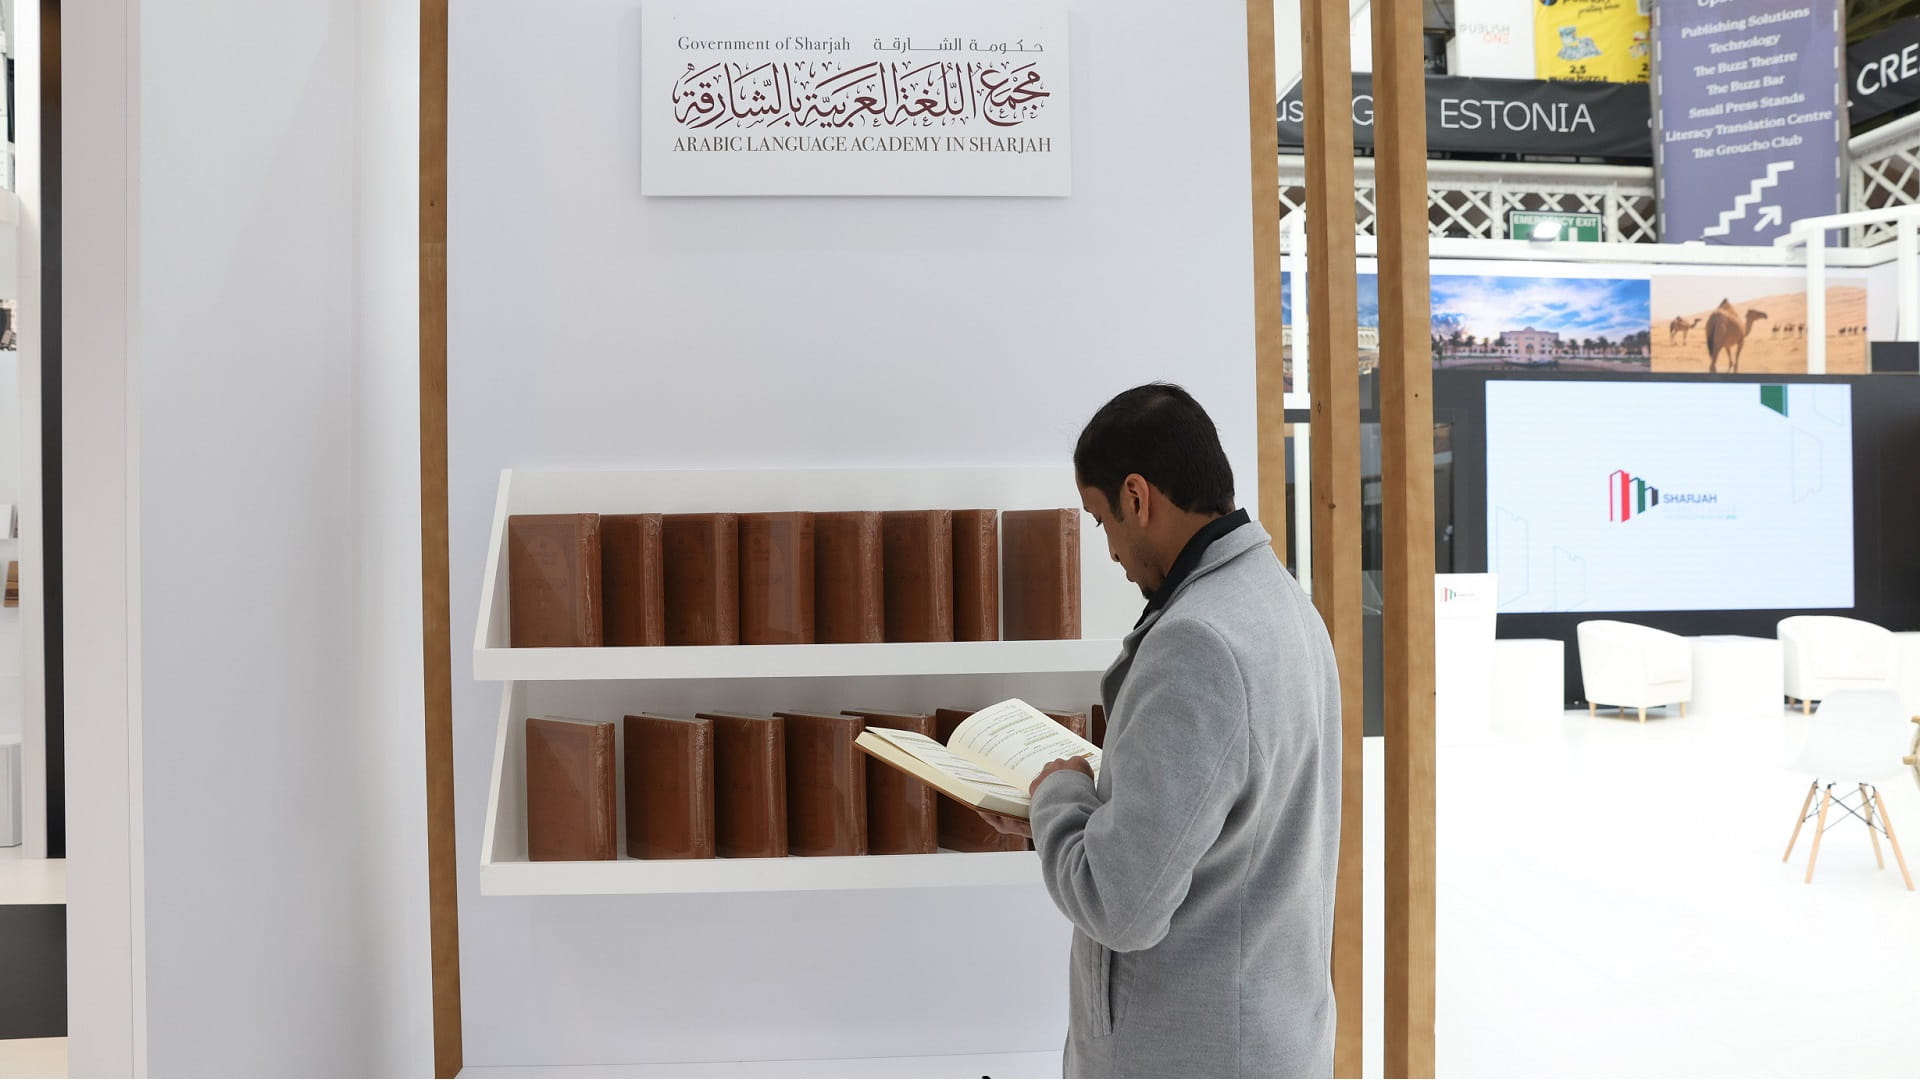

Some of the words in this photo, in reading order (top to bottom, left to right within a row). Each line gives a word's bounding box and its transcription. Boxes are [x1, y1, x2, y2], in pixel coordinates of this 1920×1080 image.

[1681, 17, 1746, 39] Publishing
[1747, 7, 1810, 27] Solutions
[677, 36, 770, 51] Government
[775, 36, 792, 51] of
[794, 36, 851, 55] Sharjah
[872, 36, 963, 54] الشارقة
[1708, 33, 1781, 54] Technology
[1693, 65, 1716, 77] The
[1717, 60, 1748, 74] Buzz
[1749, 51, 1798, 69] Theatre
[1856, 42, 1920, 96] CRE
[1706, 84, 1729, 96] The
[1730, 79, 1761, 93] Buzz
[1762, 75, 1785, 88] Bar
[1440, 98, 1596, 134] ESTONIA
[1688, 106, 1724, 119] Small
[1725, 100, 1759, 114] Press
[1760, 92, 1805, 109] Stands
[1715, 117, 1786, 136] Translation
[1787, 110, 1833, 126] Centre
[673, 136, 743, 152] ARABIC
[746, 136, 848, 153] LANGUAGE
[849, 136, 942, 152] ACADEMY
[945, 136, 966, 152] IN
[969, 136, 1053, 154] SHARJAH
[1692, 147, 1715, 159] The
[1716, 139, 1770, 156] Groucho
[1771, 134, 1803, 148] Club
[1662, 493, 1718, 504] SHARJAH
